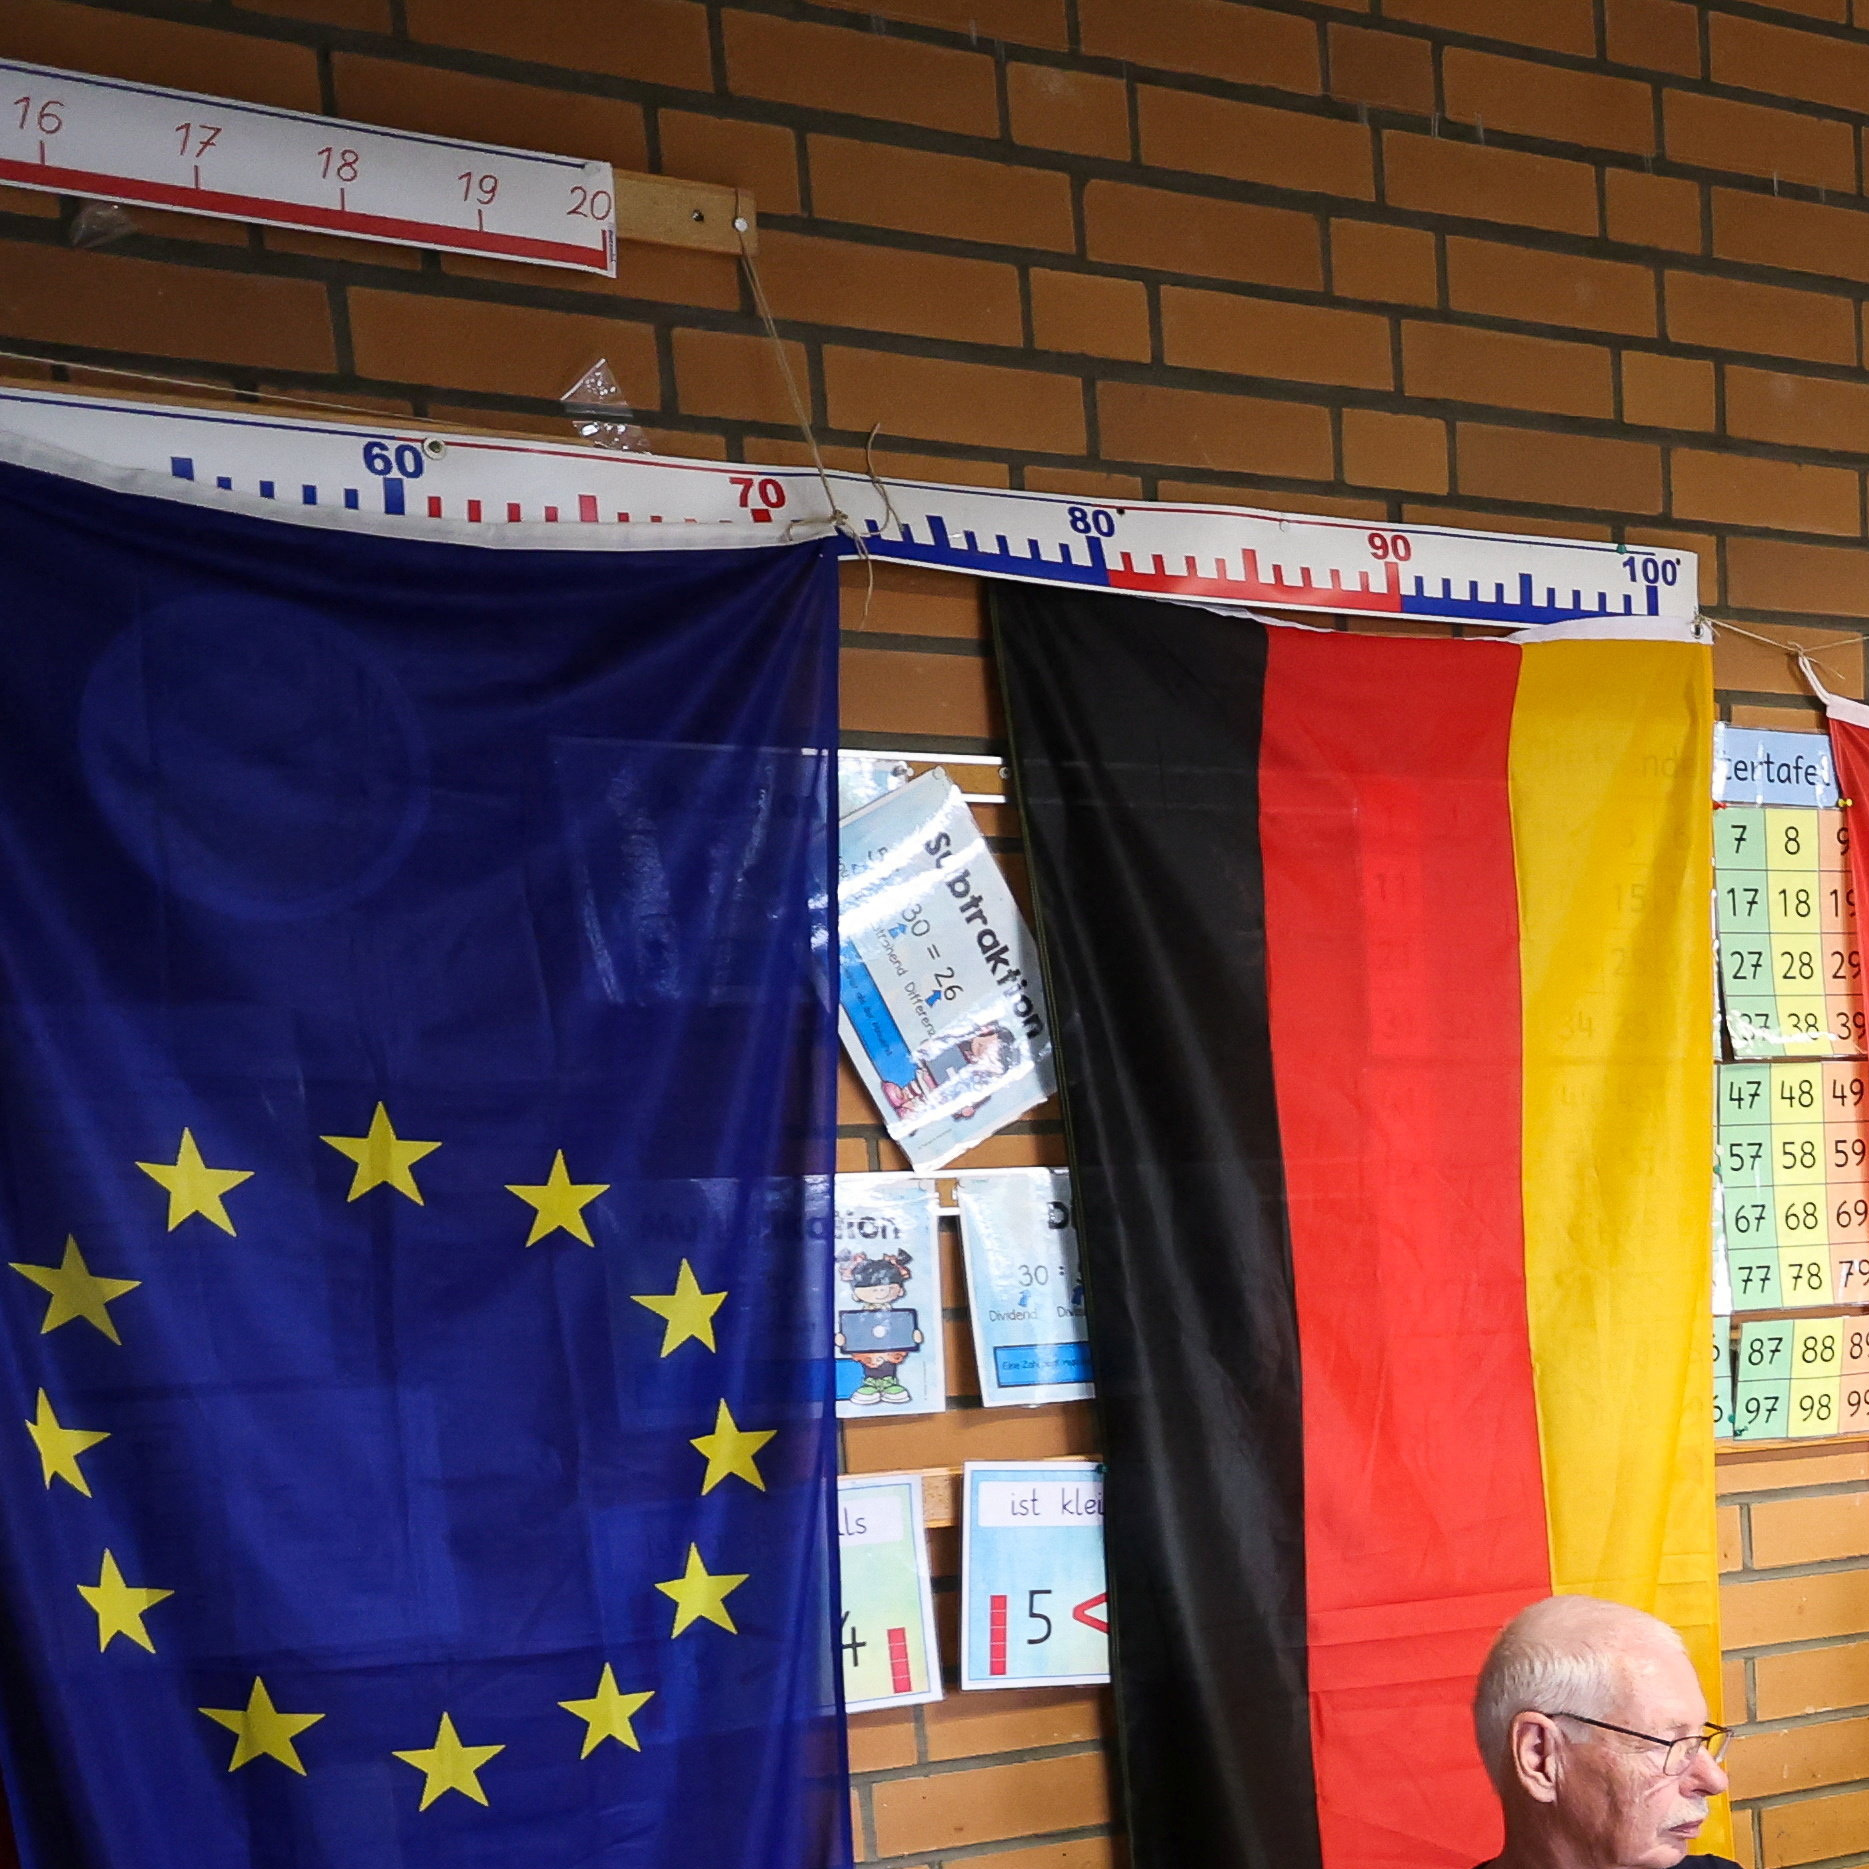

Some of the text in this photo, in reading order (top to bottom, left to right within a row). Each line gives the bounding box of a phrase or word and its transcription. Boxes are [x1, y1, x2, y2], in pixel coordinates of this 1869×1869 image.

[14, 95, 612, 221] 16 17 18 19 20
[362, 441, 1677, 588] 60 70 80 90 100
[1731, 825, 1747, 853] 7
[1785, 826, 1800, 855] 8
[1726, 888, 1759, 917] 17
[1779, 888, 1811, 918] 18
[1731, 951, 1861, 979] 27 28 29
[934, 967, 963, 1001] 26
[1788, 1013, 1819, 1040] 38
[1837, 1012, 1865, 1040] 39
[1729, 1080, 1762, 1110] 47
[1780, 1079, 1814, 1108] 48
[1832, 1078, 1864, 1107] 49
[1730, 1139, 1866, 1172] 57 58 59
[1735, 1199, 1868, 1233] 67 68 69
[1018, 1265, 1049, 1287] 30
[1738, 1265, 1771, 1294] 77
[1788, 1263, 1822, 1291] 78
[1748, 1337, 1783, 1366] 87
[1802, 1335, 1835, 1364] 88
[1745, 1396, 1779, 1424] 97
[1799, 1393, 1832, 1422] 98
[1011, 1487, 1104, 1517] ist klei
[1027, 1589, 1052, 1645] 5
